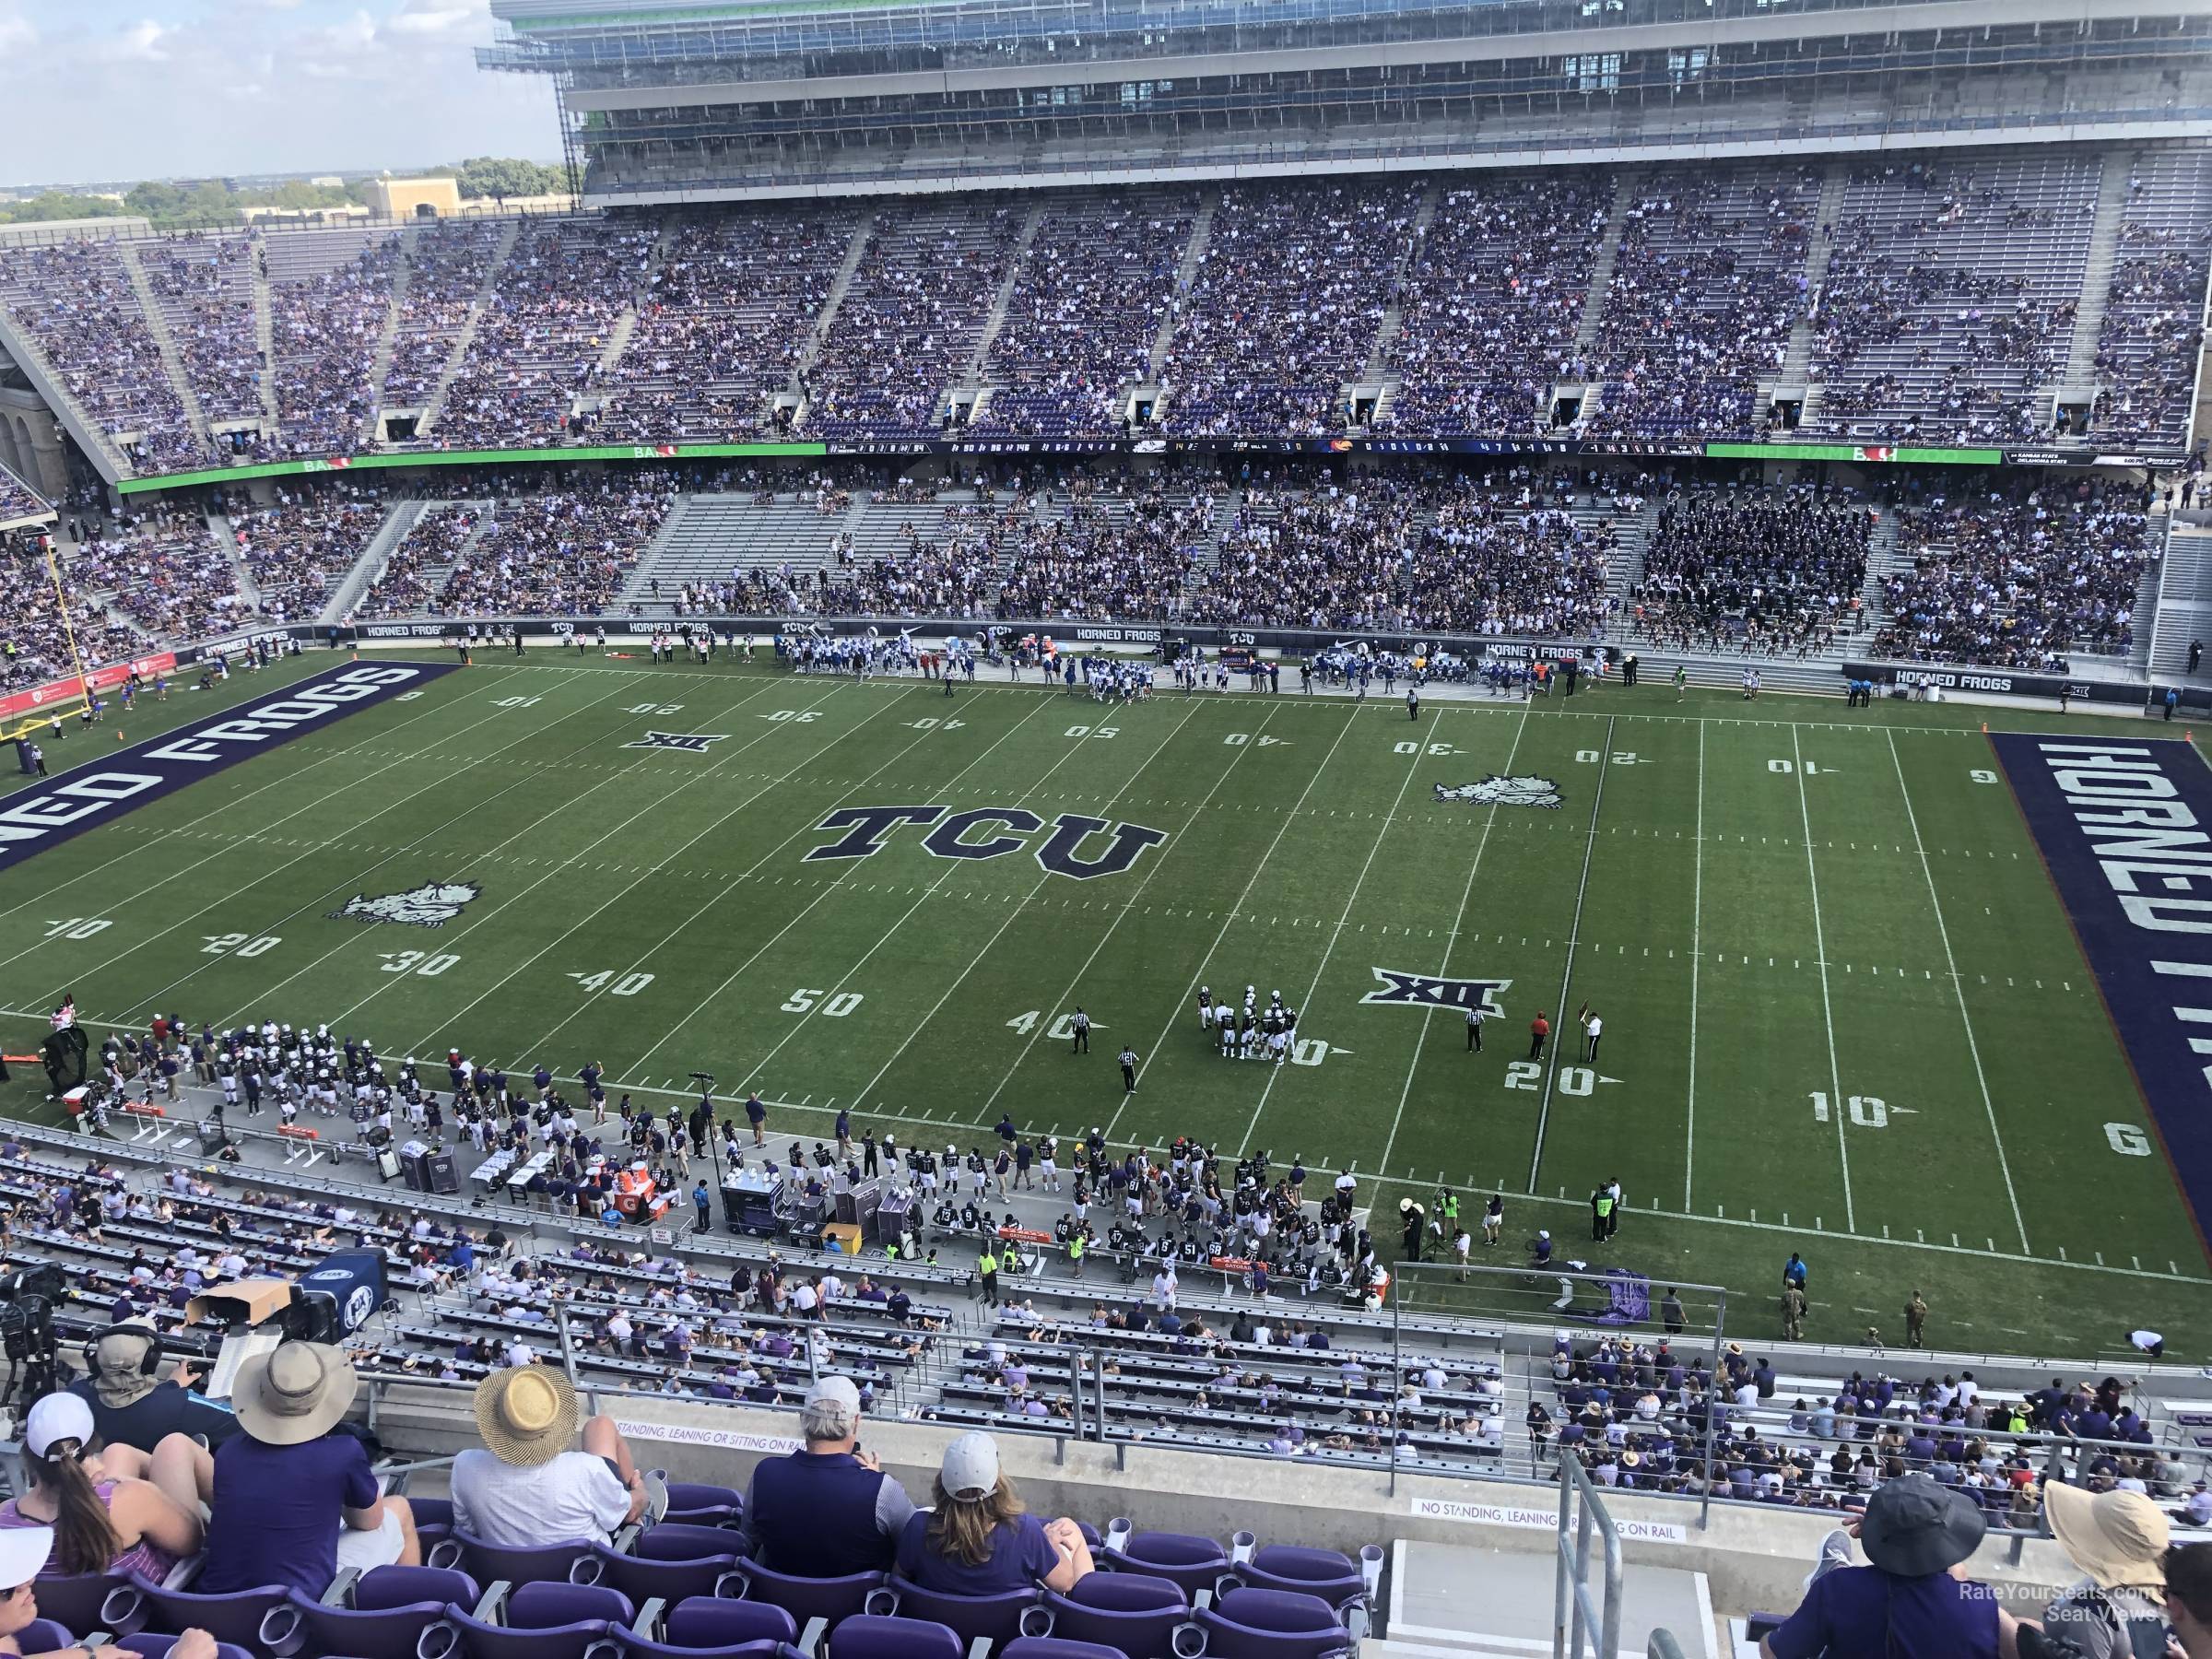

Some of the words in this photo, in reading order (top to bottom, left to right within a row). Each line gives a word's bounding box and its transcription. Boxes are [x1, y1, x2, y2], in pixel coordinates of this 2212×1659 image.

[1853, 447, 1897, 461] BH
[368, 626, 409, 637] HORNED
[551, 623, 575, 634] TCU
[629, 622, 671, 633] HORNED
[675, 623, 709, 634] FOGS
[782, 622, 806, 634] TCU
[1077, 629, 1122, 641] HORNED
[1124, 629, 1161, 641] FROGS
[1230, 632, 1255, 645] TCU
[1486, 644, 1535, 657] HORNE
[1541, 647, 1583, 659] FROGS
[1961, 676, 2011, 691] FROGS
[498, 696, 543, 708] 10
[142, 666, 420, 762] FROGS
[629, 703, 685, 715] 20
[768, 711, 824, 723] 30
[912, 718, 967, 730] 40
[1064, 725, 1121, 739] 50
[1223, 734, 1280, 747] 40
[1394, 741, 1453, 756] 30
[1575, 750, 1638, 765] 20
[1768, 759, 1819, 775] 10
[1969, 770, 1998, 783] G
[800, 805, 1169, 880] TCU
[44, 918, 113, 940] 10
[200, 933, 282, 958] 20
[381, 950, 461, 976] 30
[577, 970, 655, 996] 40
[780, 988, 864, 1018] 50
[1006, 1010, 1076, 1040] 40
[1124, 1054, 1130, 1063] C
[1504, 1061, 1594, 1097] 20
[1808, 1091, 1888, 1128] 10
[2103, 1123, 2151, 1157] G
[1129, 1182, 1139, 1191] 81
[624, 1198, 636, 1211] G
[941, 1210, 950, 1222] 13
[965, 1212, 972, 1222] 9
[1112, 1233, 1123, 1242] 47
[1161, 1242, 1169, 1252] 6
[1185, 1244, 1195, 1255] 51
[1209, 1244, 1222, 1255] 68
[1294, 1265, 1307, 1275] 56
[1323, 1272, 1335, 1283] 62
[618, 1422, 665, 1439] STANDING,
[669, 1429, 712, 1441] LEANING
[713, 1433, 728, 1443] OR
[729, 1435, 767, 1449] SITTING
[769, 1440, 785, 1451] ON
[1421, 1502, 1440, 1513] NO
[1443, 1503, 1504, 1523] STANDING,
[1508, 1510, 1558, 1526] LEANING
[1630, 1523, 1648, 1535] ON
[1652, 1526, 1676, 1539] RAIL
